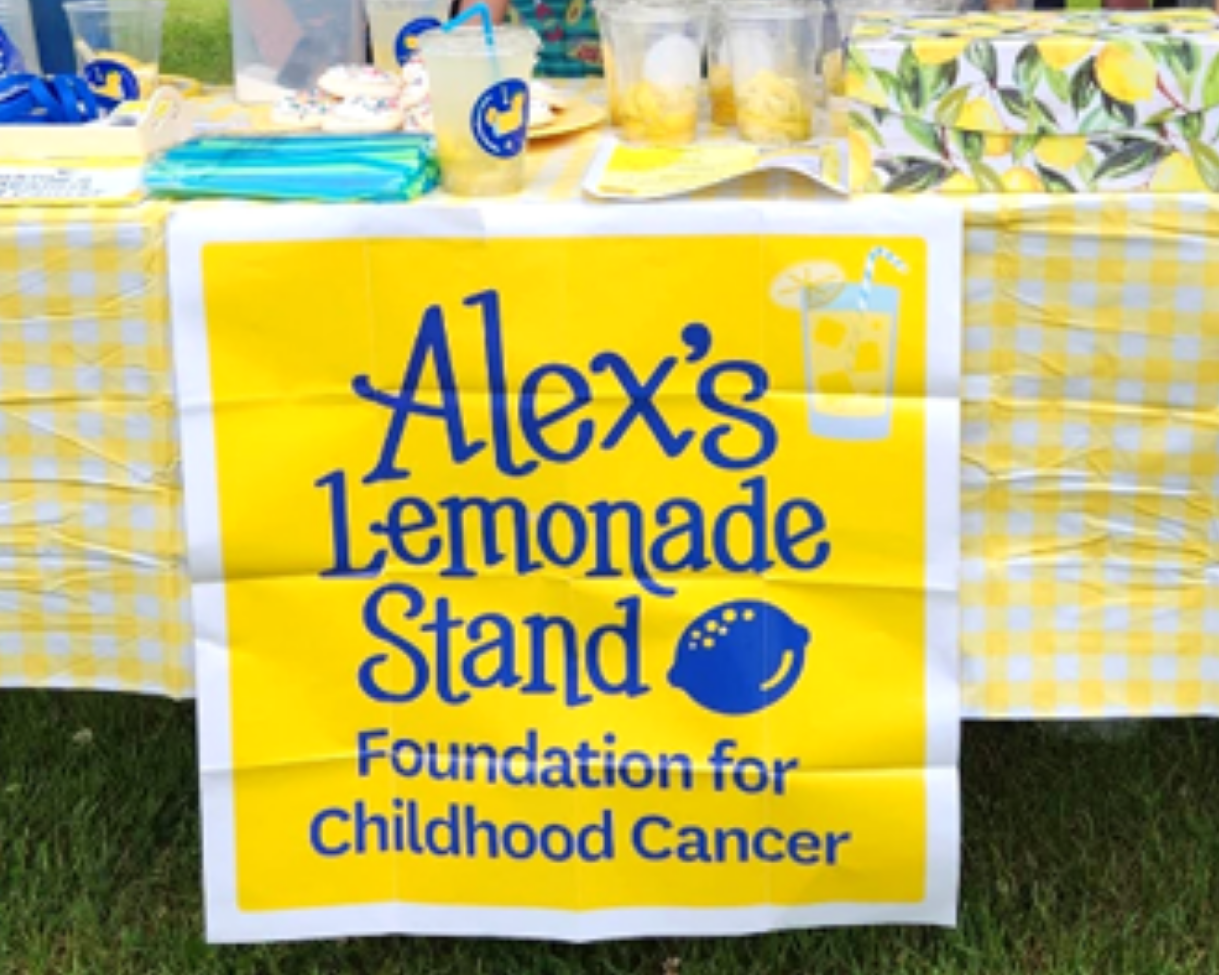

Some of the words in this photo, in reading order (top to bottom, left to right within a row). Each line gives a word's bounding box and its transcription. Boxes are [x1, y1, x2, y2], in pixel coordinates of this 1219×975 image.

[351, 289, 779, 484] Alex's
[314, 470, 832, 598] Lemonade
[357, 583, 650, 708] Stand
[357, 729, 693, 791] Foundation
[709, 740, 798, 795] for
[309, 800, 614, 864] Childhood
[633, 815, 851, 866] Cancer
